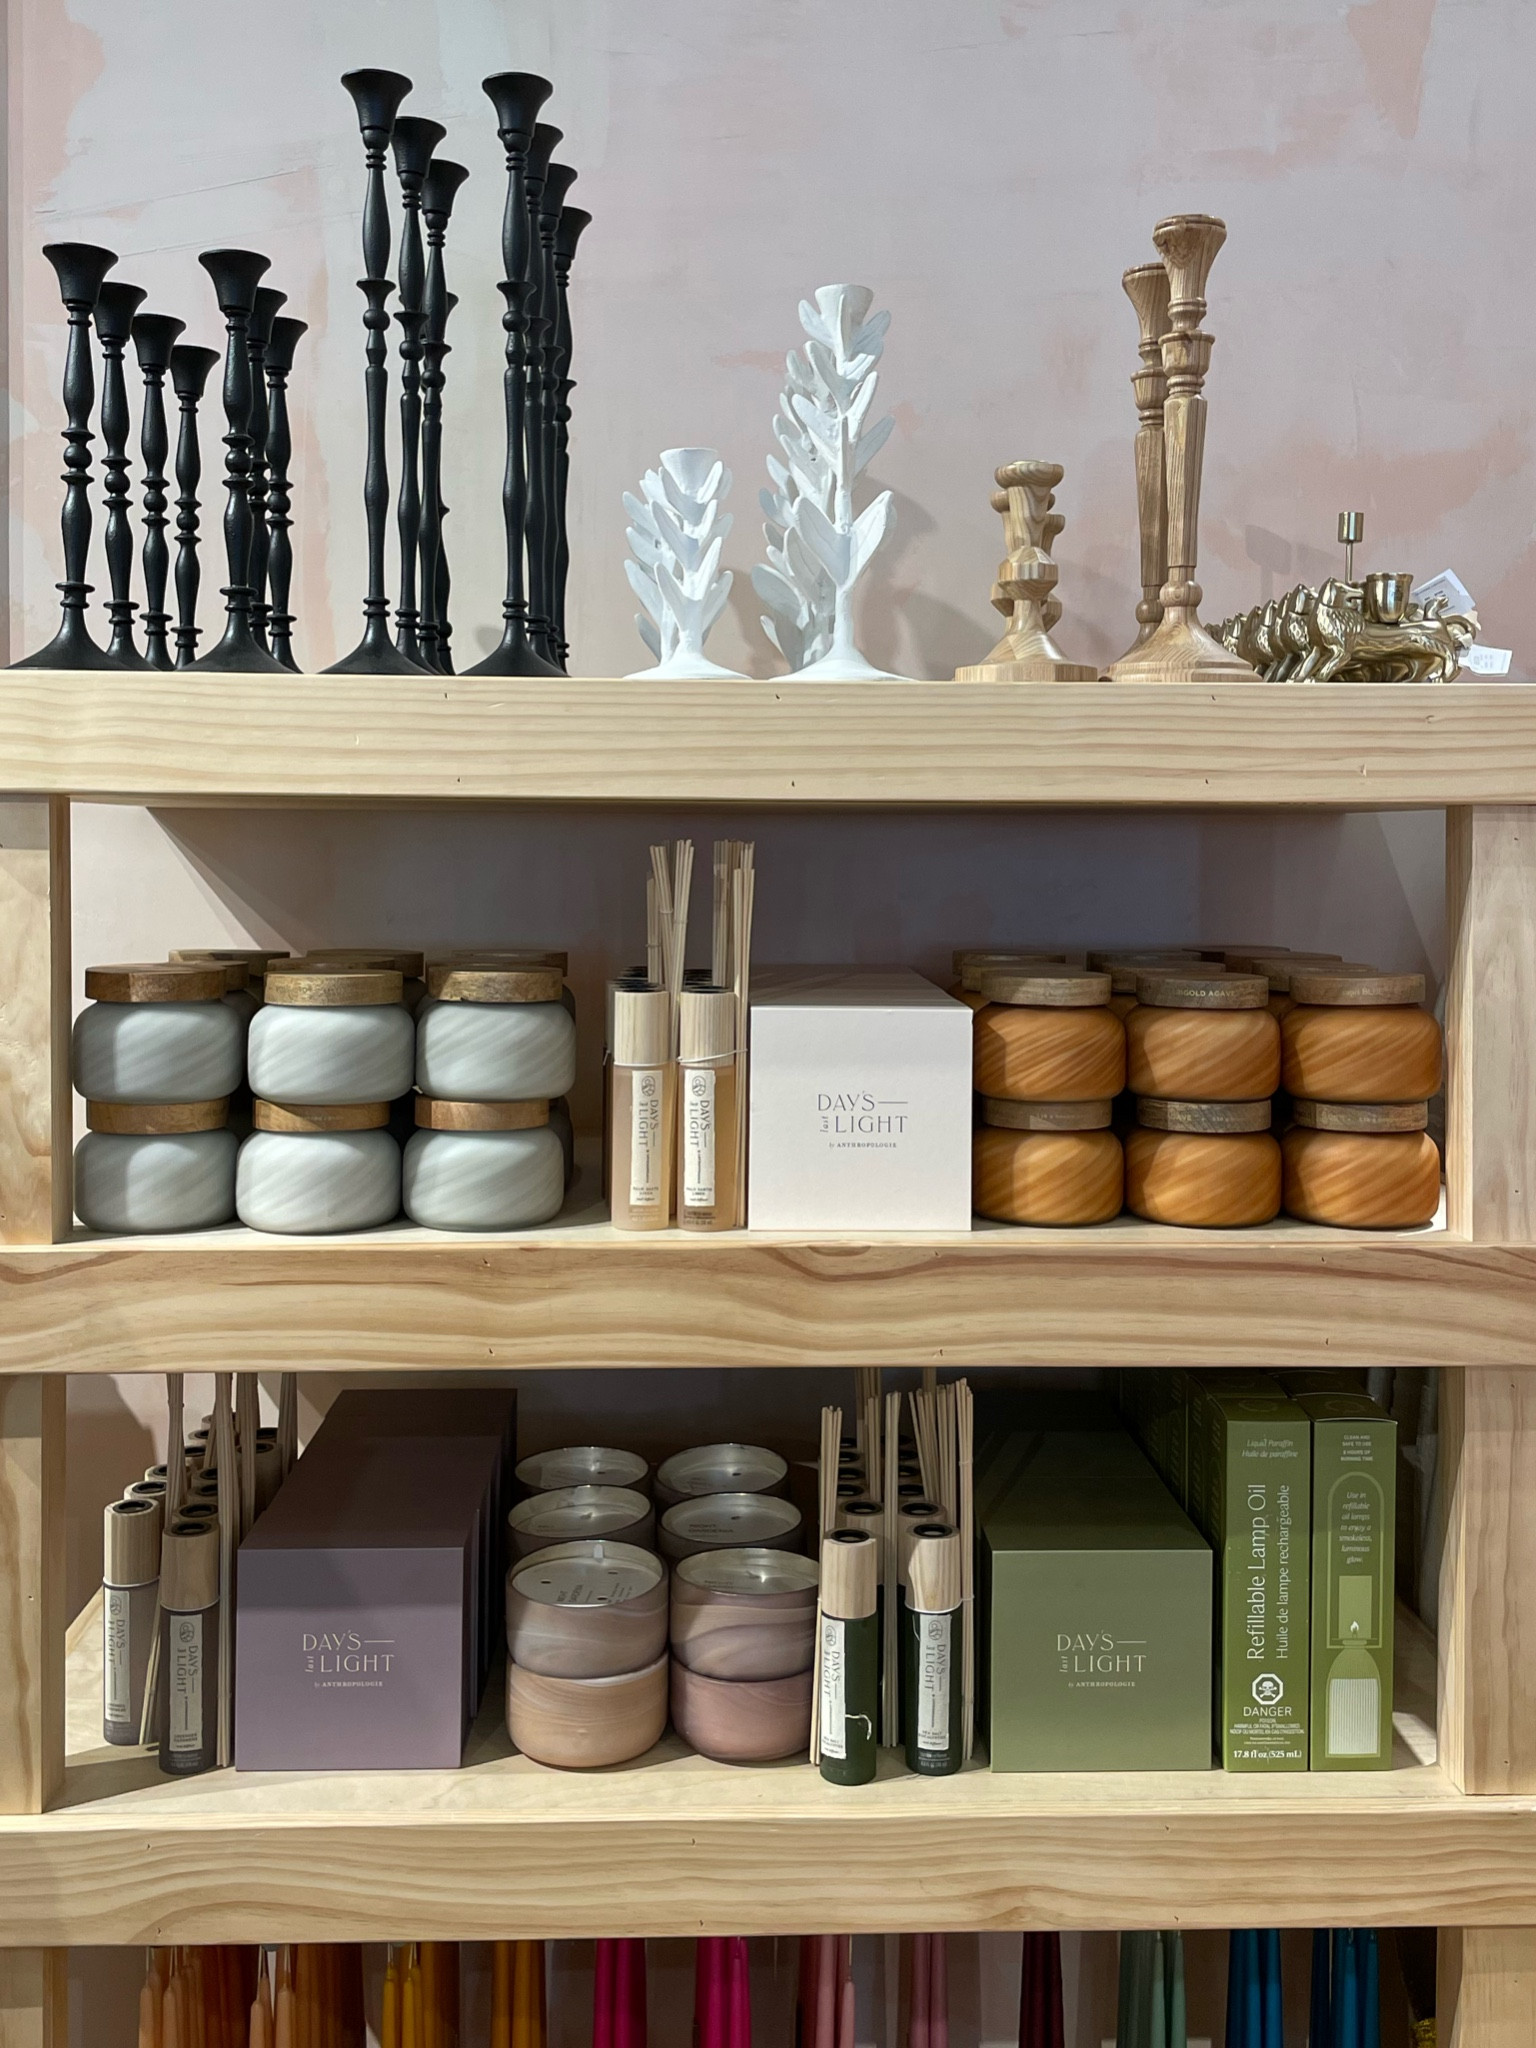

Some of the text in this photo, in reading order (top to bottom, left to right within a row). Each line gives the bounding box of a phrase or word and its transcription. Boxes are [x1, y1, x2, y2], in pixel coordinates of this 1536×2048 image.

[639, 1109, 648, 1147] LIGHT
[690, 1109, 699, 1148] LIGHT
[835, 1115, 908, 1133] LIGHT
[1268, 1438, 1294, 1449] Paraffin
[1269, 1450, 1299, 1460] paraffine
[1342, 1502, 1370, 1511] refillable
[1351, 1513, 1370, 1521] lamps
[1348, 1524, 1365, 1532] enjoy
[1247, 1485, 1270, 1659] Refillable Lamp Oil
[1276, 1485, 1292, 1659] Huile de lampe rechargeable
[321, 1654, 395, 1672] LIGHT
[925, 1652, 935, 1691] LIGHT
[1074, 1655, 1147, 1672] LIGHT
[177, 1655, 187, 1693] LIGHT
[1243, 1706, 1292, 1717] DANGER
[1234, 1750, 1249, 1758] 17.8
[1251, 1750, 1257, 1758] fl
[1269, 1750, 1285, 1758] (525
